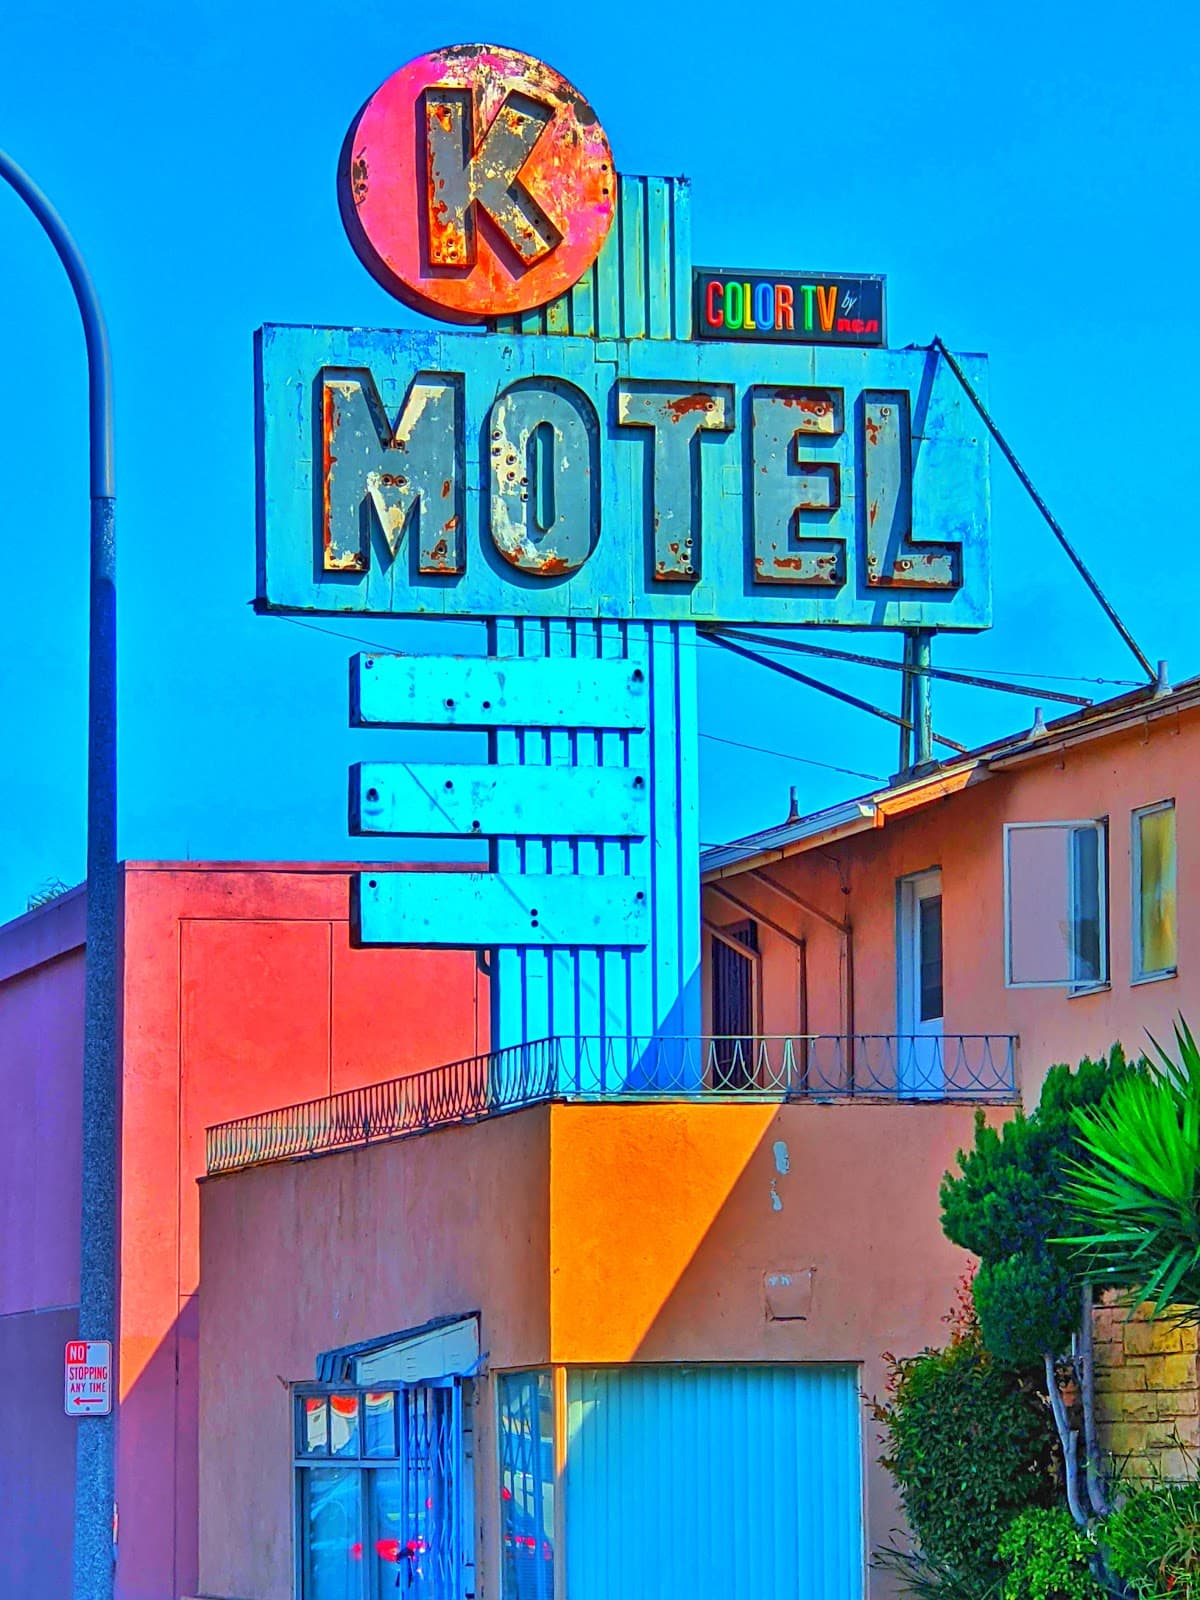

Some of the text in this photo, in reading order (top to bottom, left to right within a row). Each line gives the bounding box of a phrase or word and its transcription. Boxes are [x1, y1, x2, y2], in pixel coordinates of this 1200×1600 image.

[415, 87, 565, 268] K
[705, 281, 839, 332] COLOR TV
[840, 290, 858, 317] by
[837, 317, 879, 334] RCA
[318, 366, 963, 588] MOTEL
[69, 1345, 85, 1361] NO
[69, 1366, 108, 1380] STOPPING
[70, 1382, 107, 1393] ANY TIME
